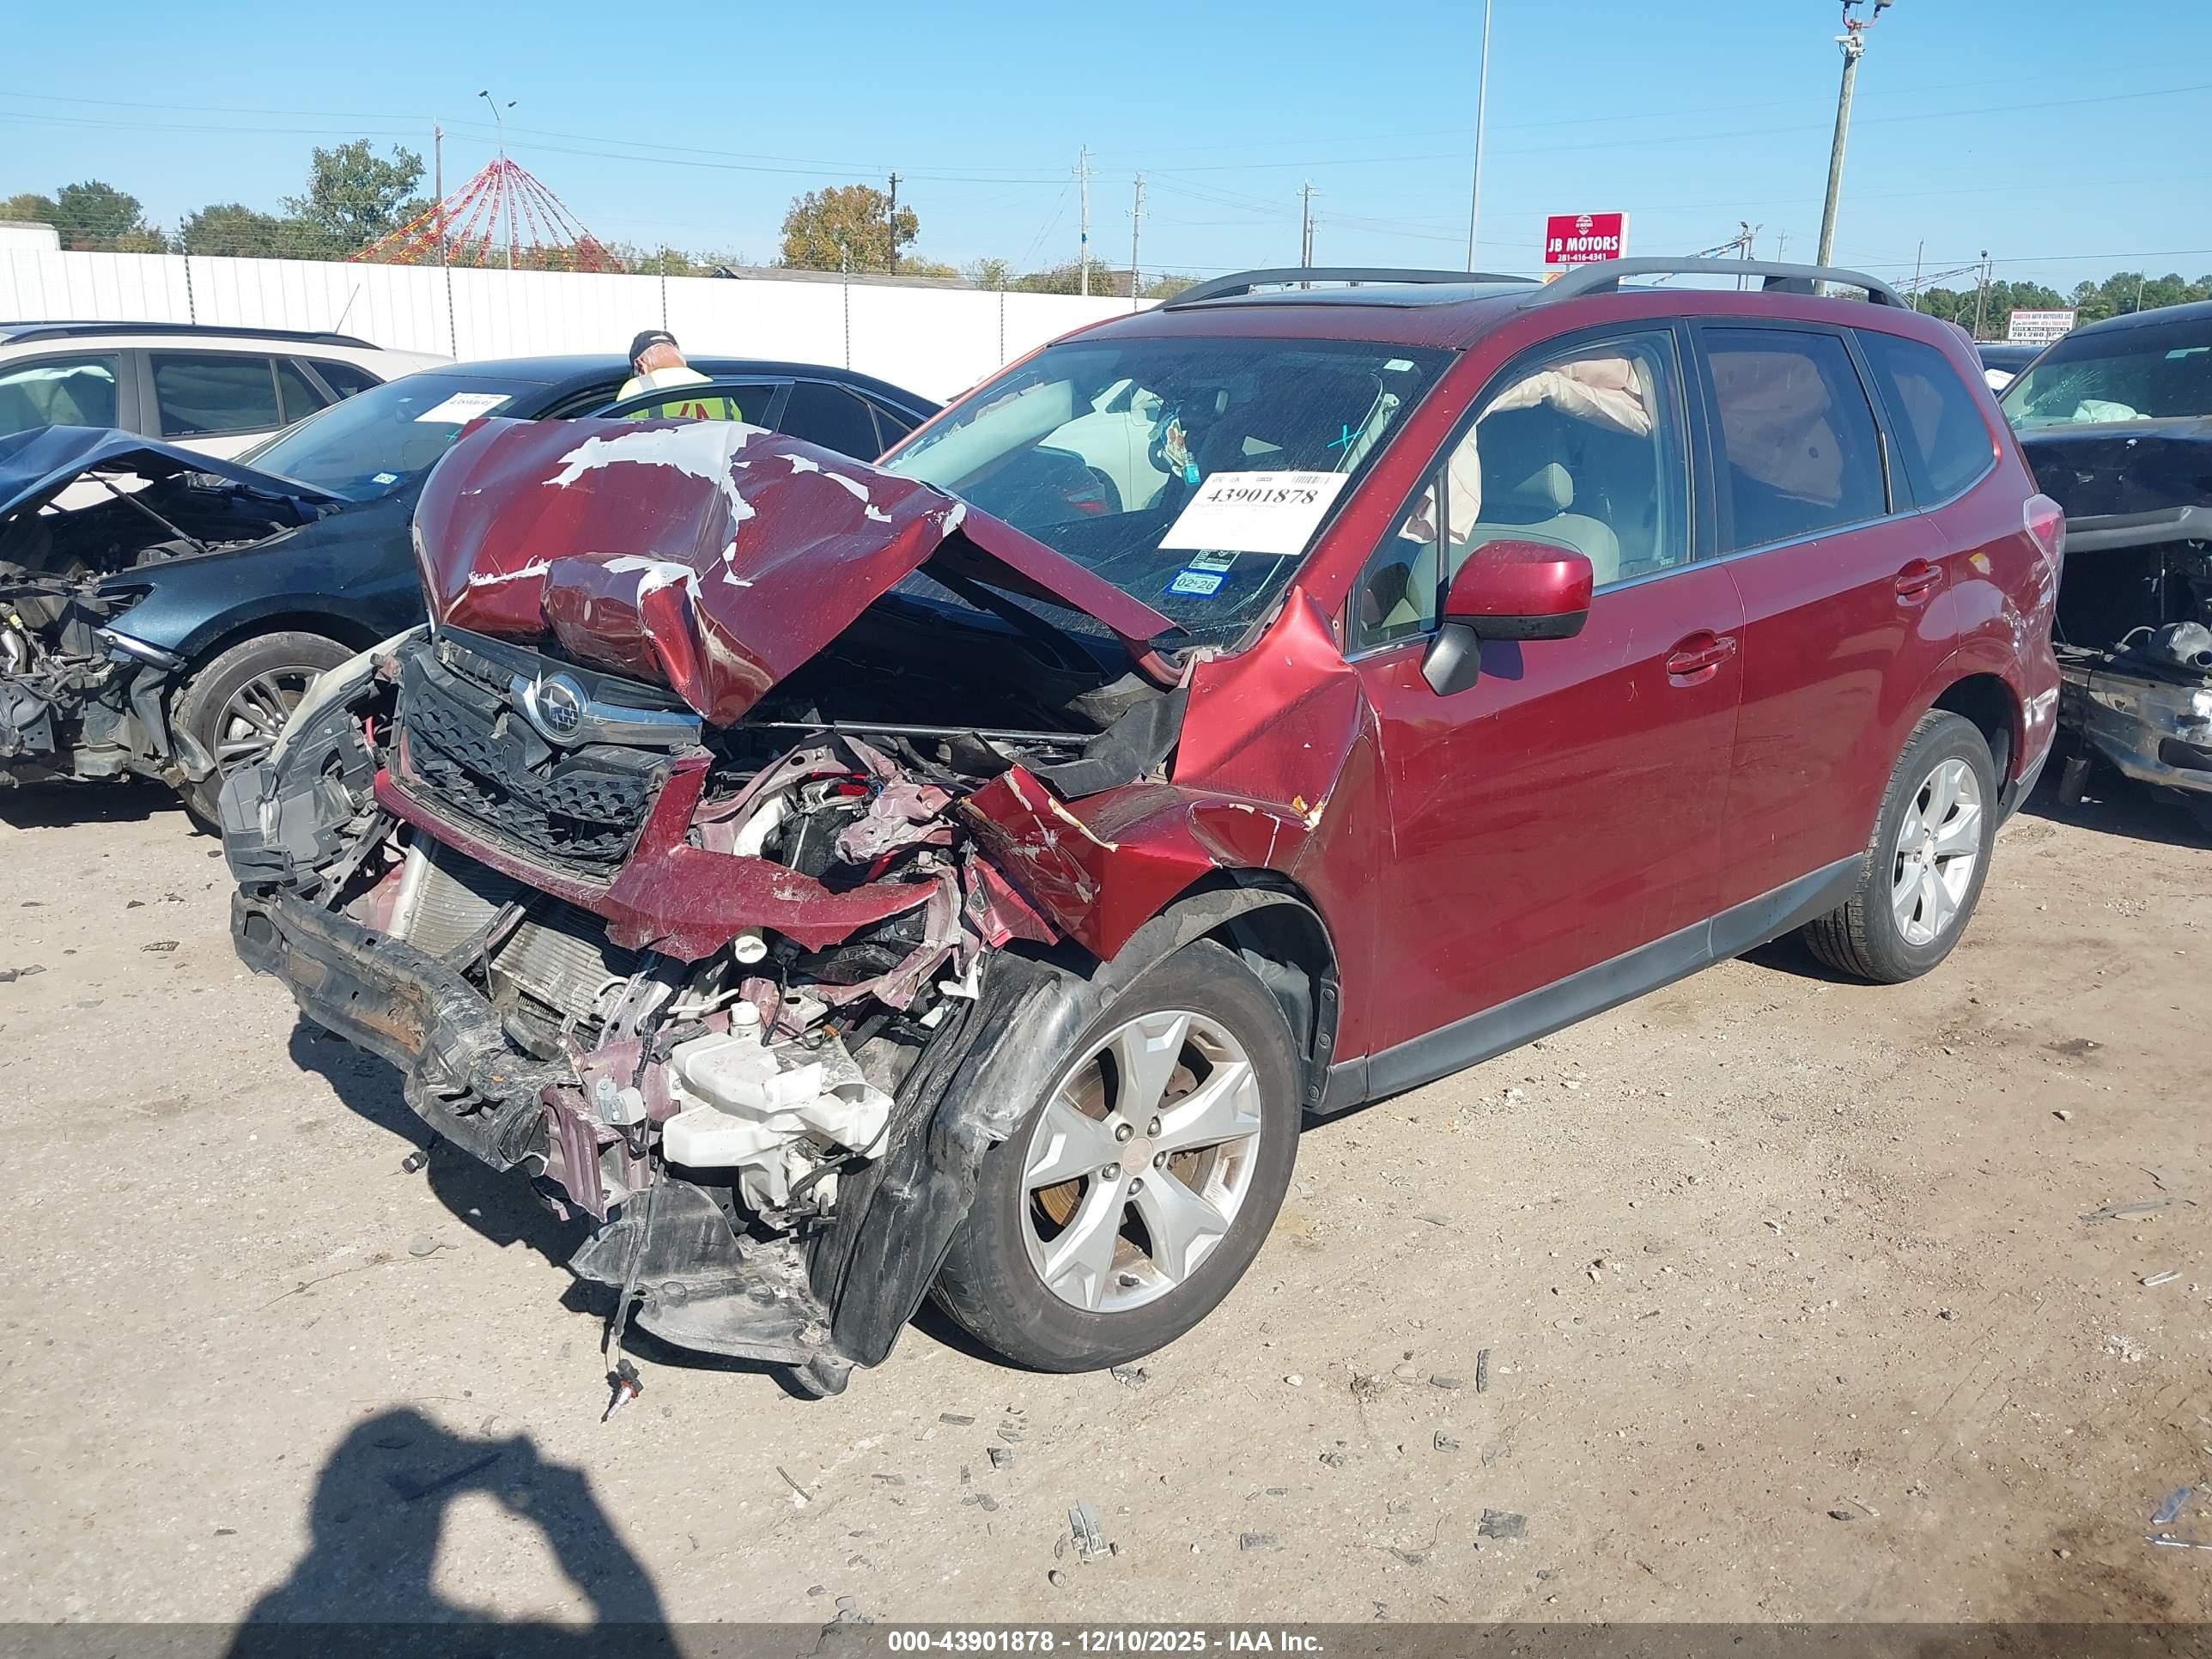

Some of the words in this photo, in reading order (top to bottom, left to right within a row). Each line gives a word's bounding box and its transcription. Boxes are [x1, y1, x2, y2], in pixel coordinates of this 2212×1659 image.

[1547, 238, 1563, 252] JB
[1565, 235, 1619, 252] MOTORS
[1557, 252, 1607, 262] 281-416-4341
[1206, 489, 1318, 504] 43901878
